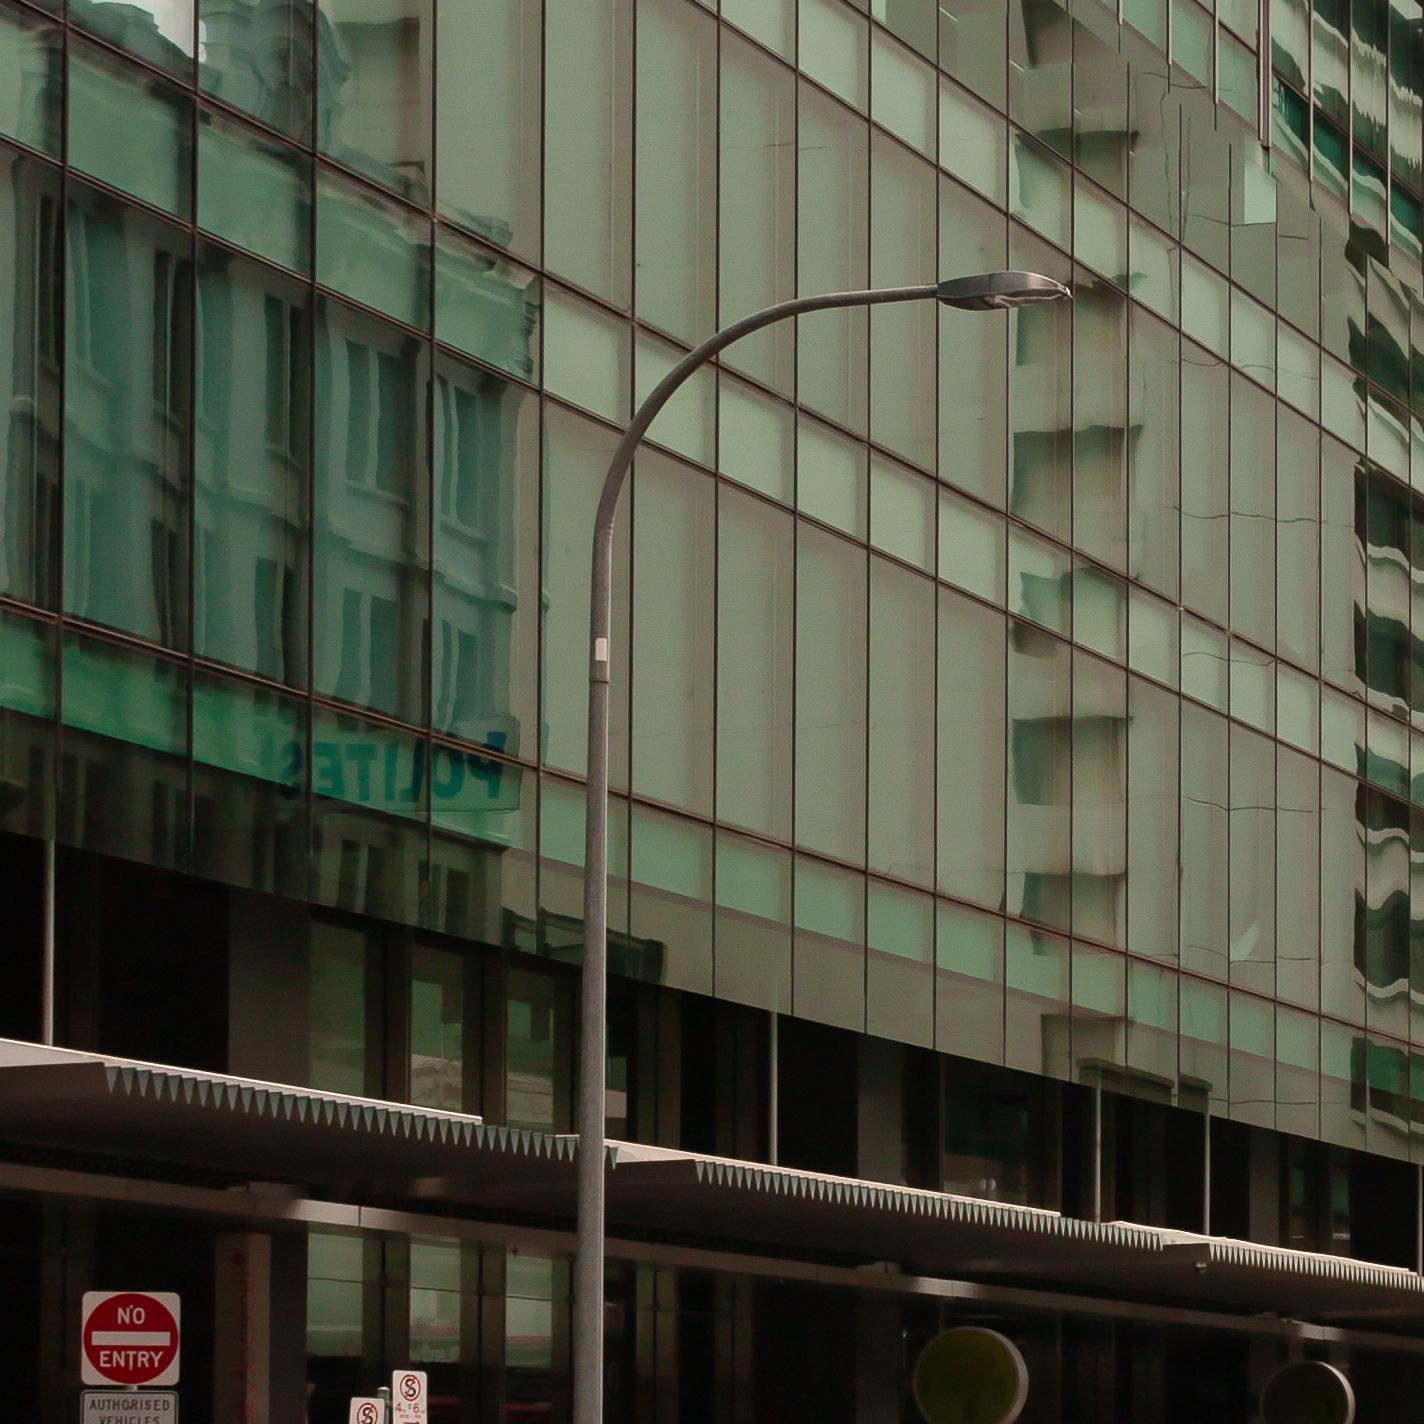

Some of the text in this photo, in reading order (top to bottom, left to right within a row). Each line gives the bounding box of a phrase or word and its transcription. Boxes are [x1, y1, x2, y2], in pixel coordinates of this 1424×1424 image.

[117, 1307, 145, 1324] NO
[99, 1350, 164, 1368] ENTRY
[89, 1399, 170, 1411] AUTHORISED
